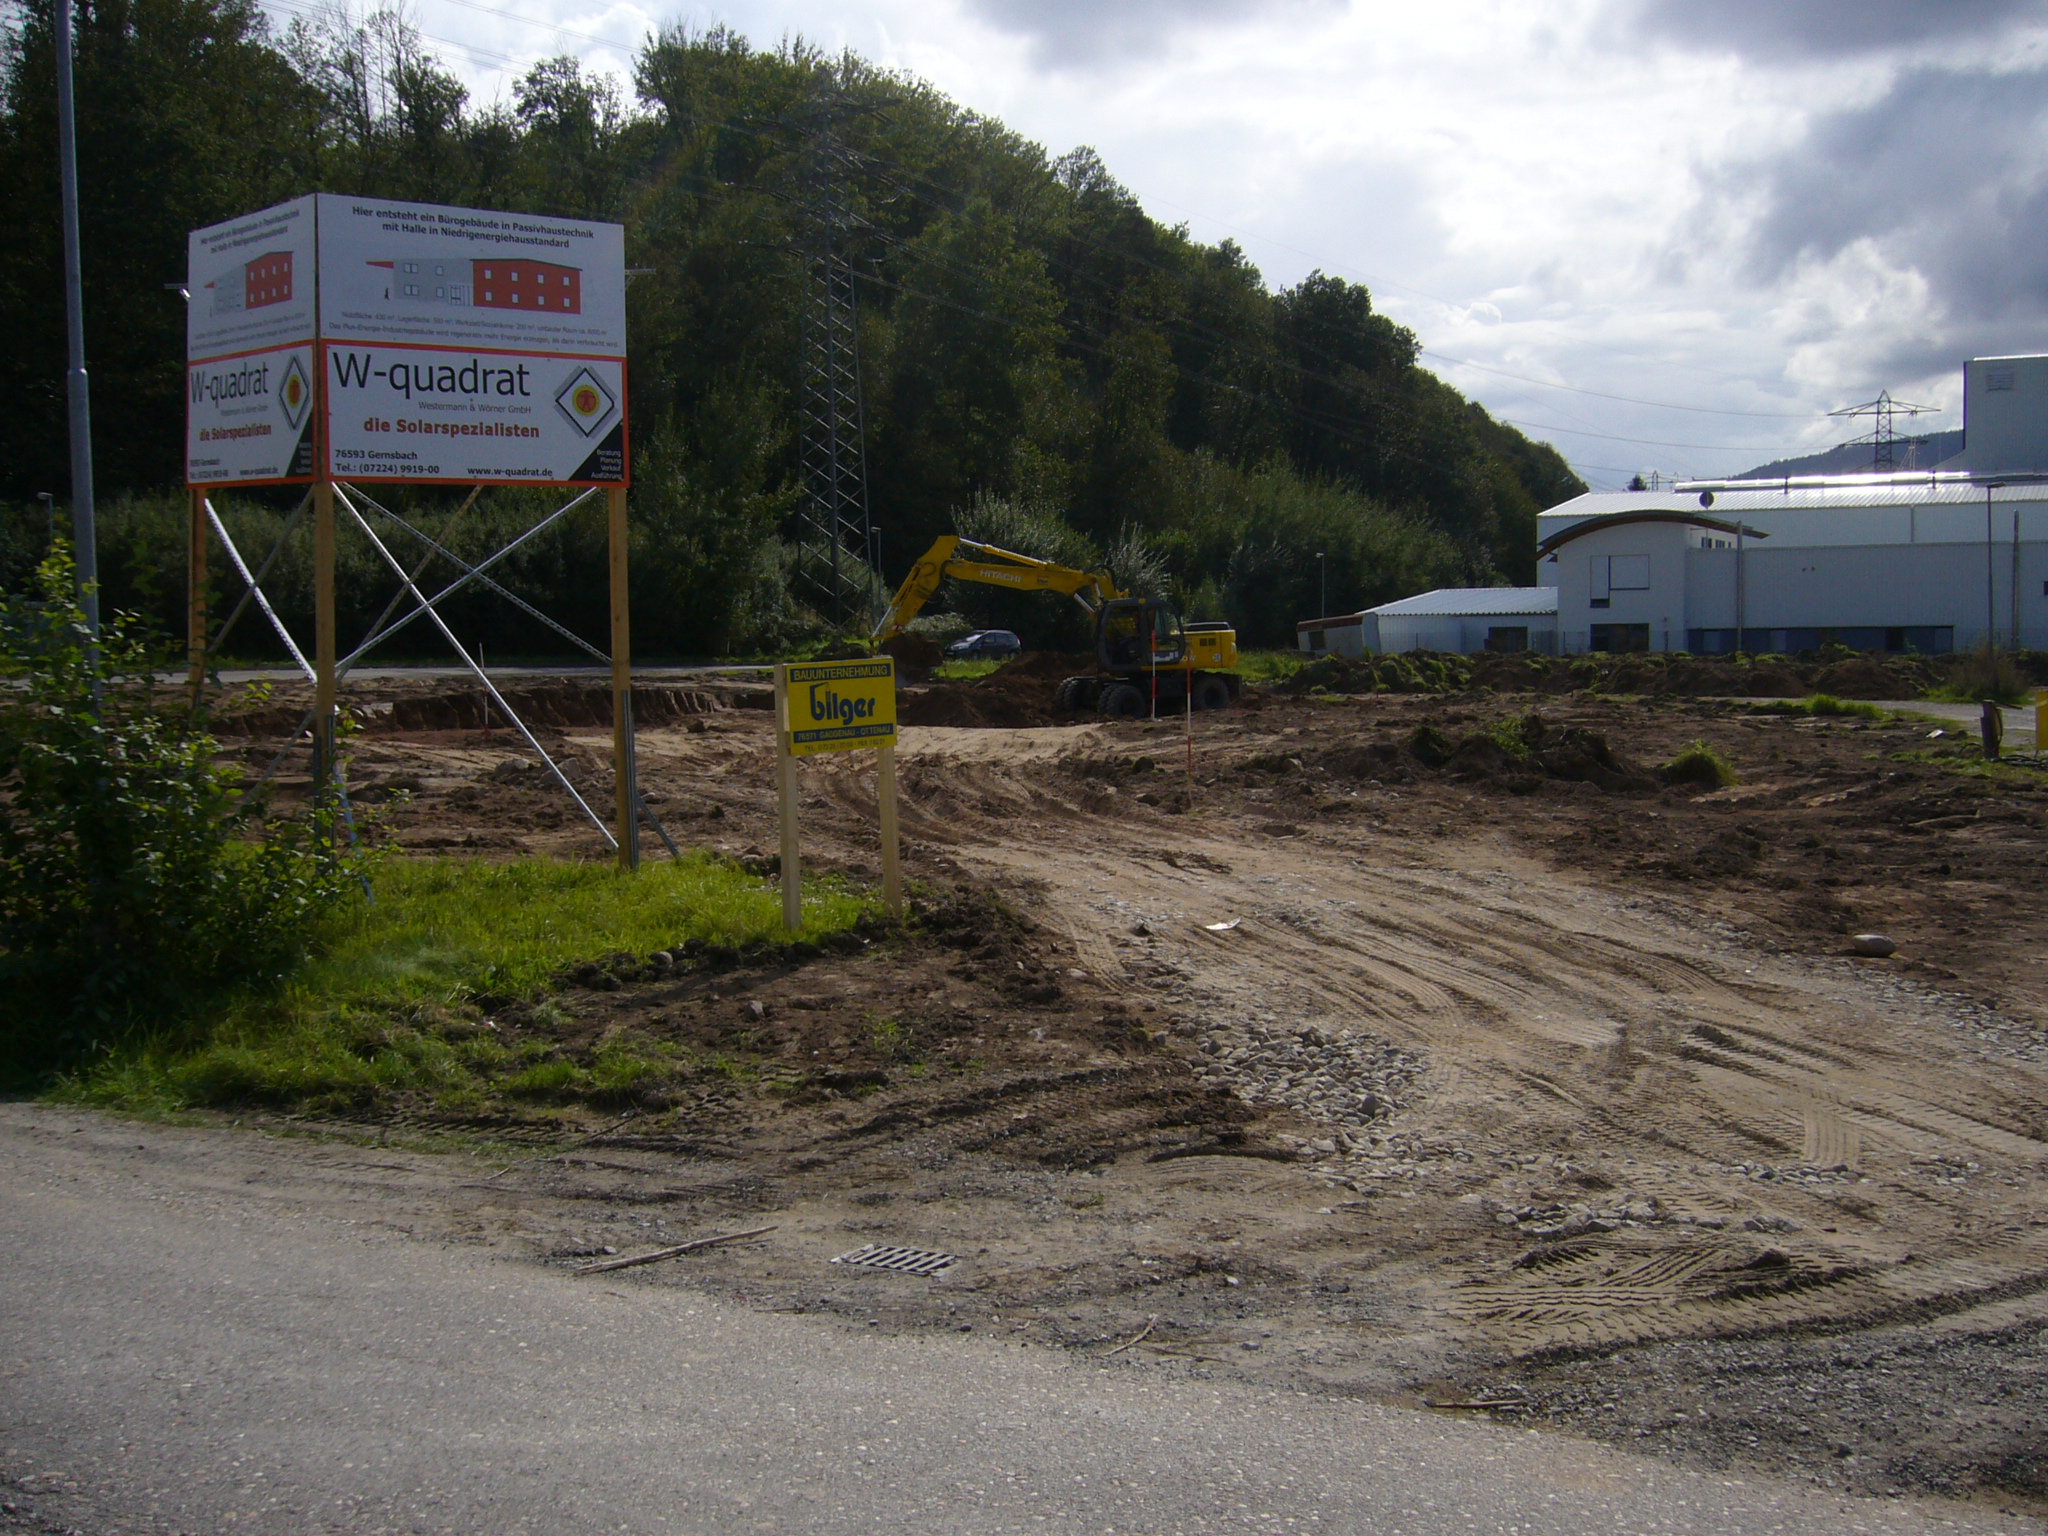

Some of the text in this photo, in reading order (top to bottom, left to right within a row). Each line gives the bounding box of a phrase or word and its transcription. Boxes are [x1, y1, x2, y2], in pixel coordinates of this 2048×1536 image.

[352, 206, 595, 239] Hier entsteht ein Bürogebäude in Passivhaustechnik
[382, 222, 570, 249] mit Halle in Niedrigenergiehausstandard
[190, 361, 269, 408] W-quadrat
[333, 351, 531, 400] W-quadrat
[418, 401, 467, 412] Westermann
[478, 403, 506, 413] Wörner
[508, 405, 532, 414] GmbH
[364, 417, 540, 438] die Solarspezialisten
[335, 449, 418, 461] 76593 Gernsbach
[335, 463, 440, 475] Tel.: (07224) 9919-00
[467, 467, 553, 477] www.w-quadrat.de
[980, 569, 1022, 583] HITACHI
[794, 665, 888, 680] BAUUNTERNEHMUNG
[809, 682, 876, 726] bilger
